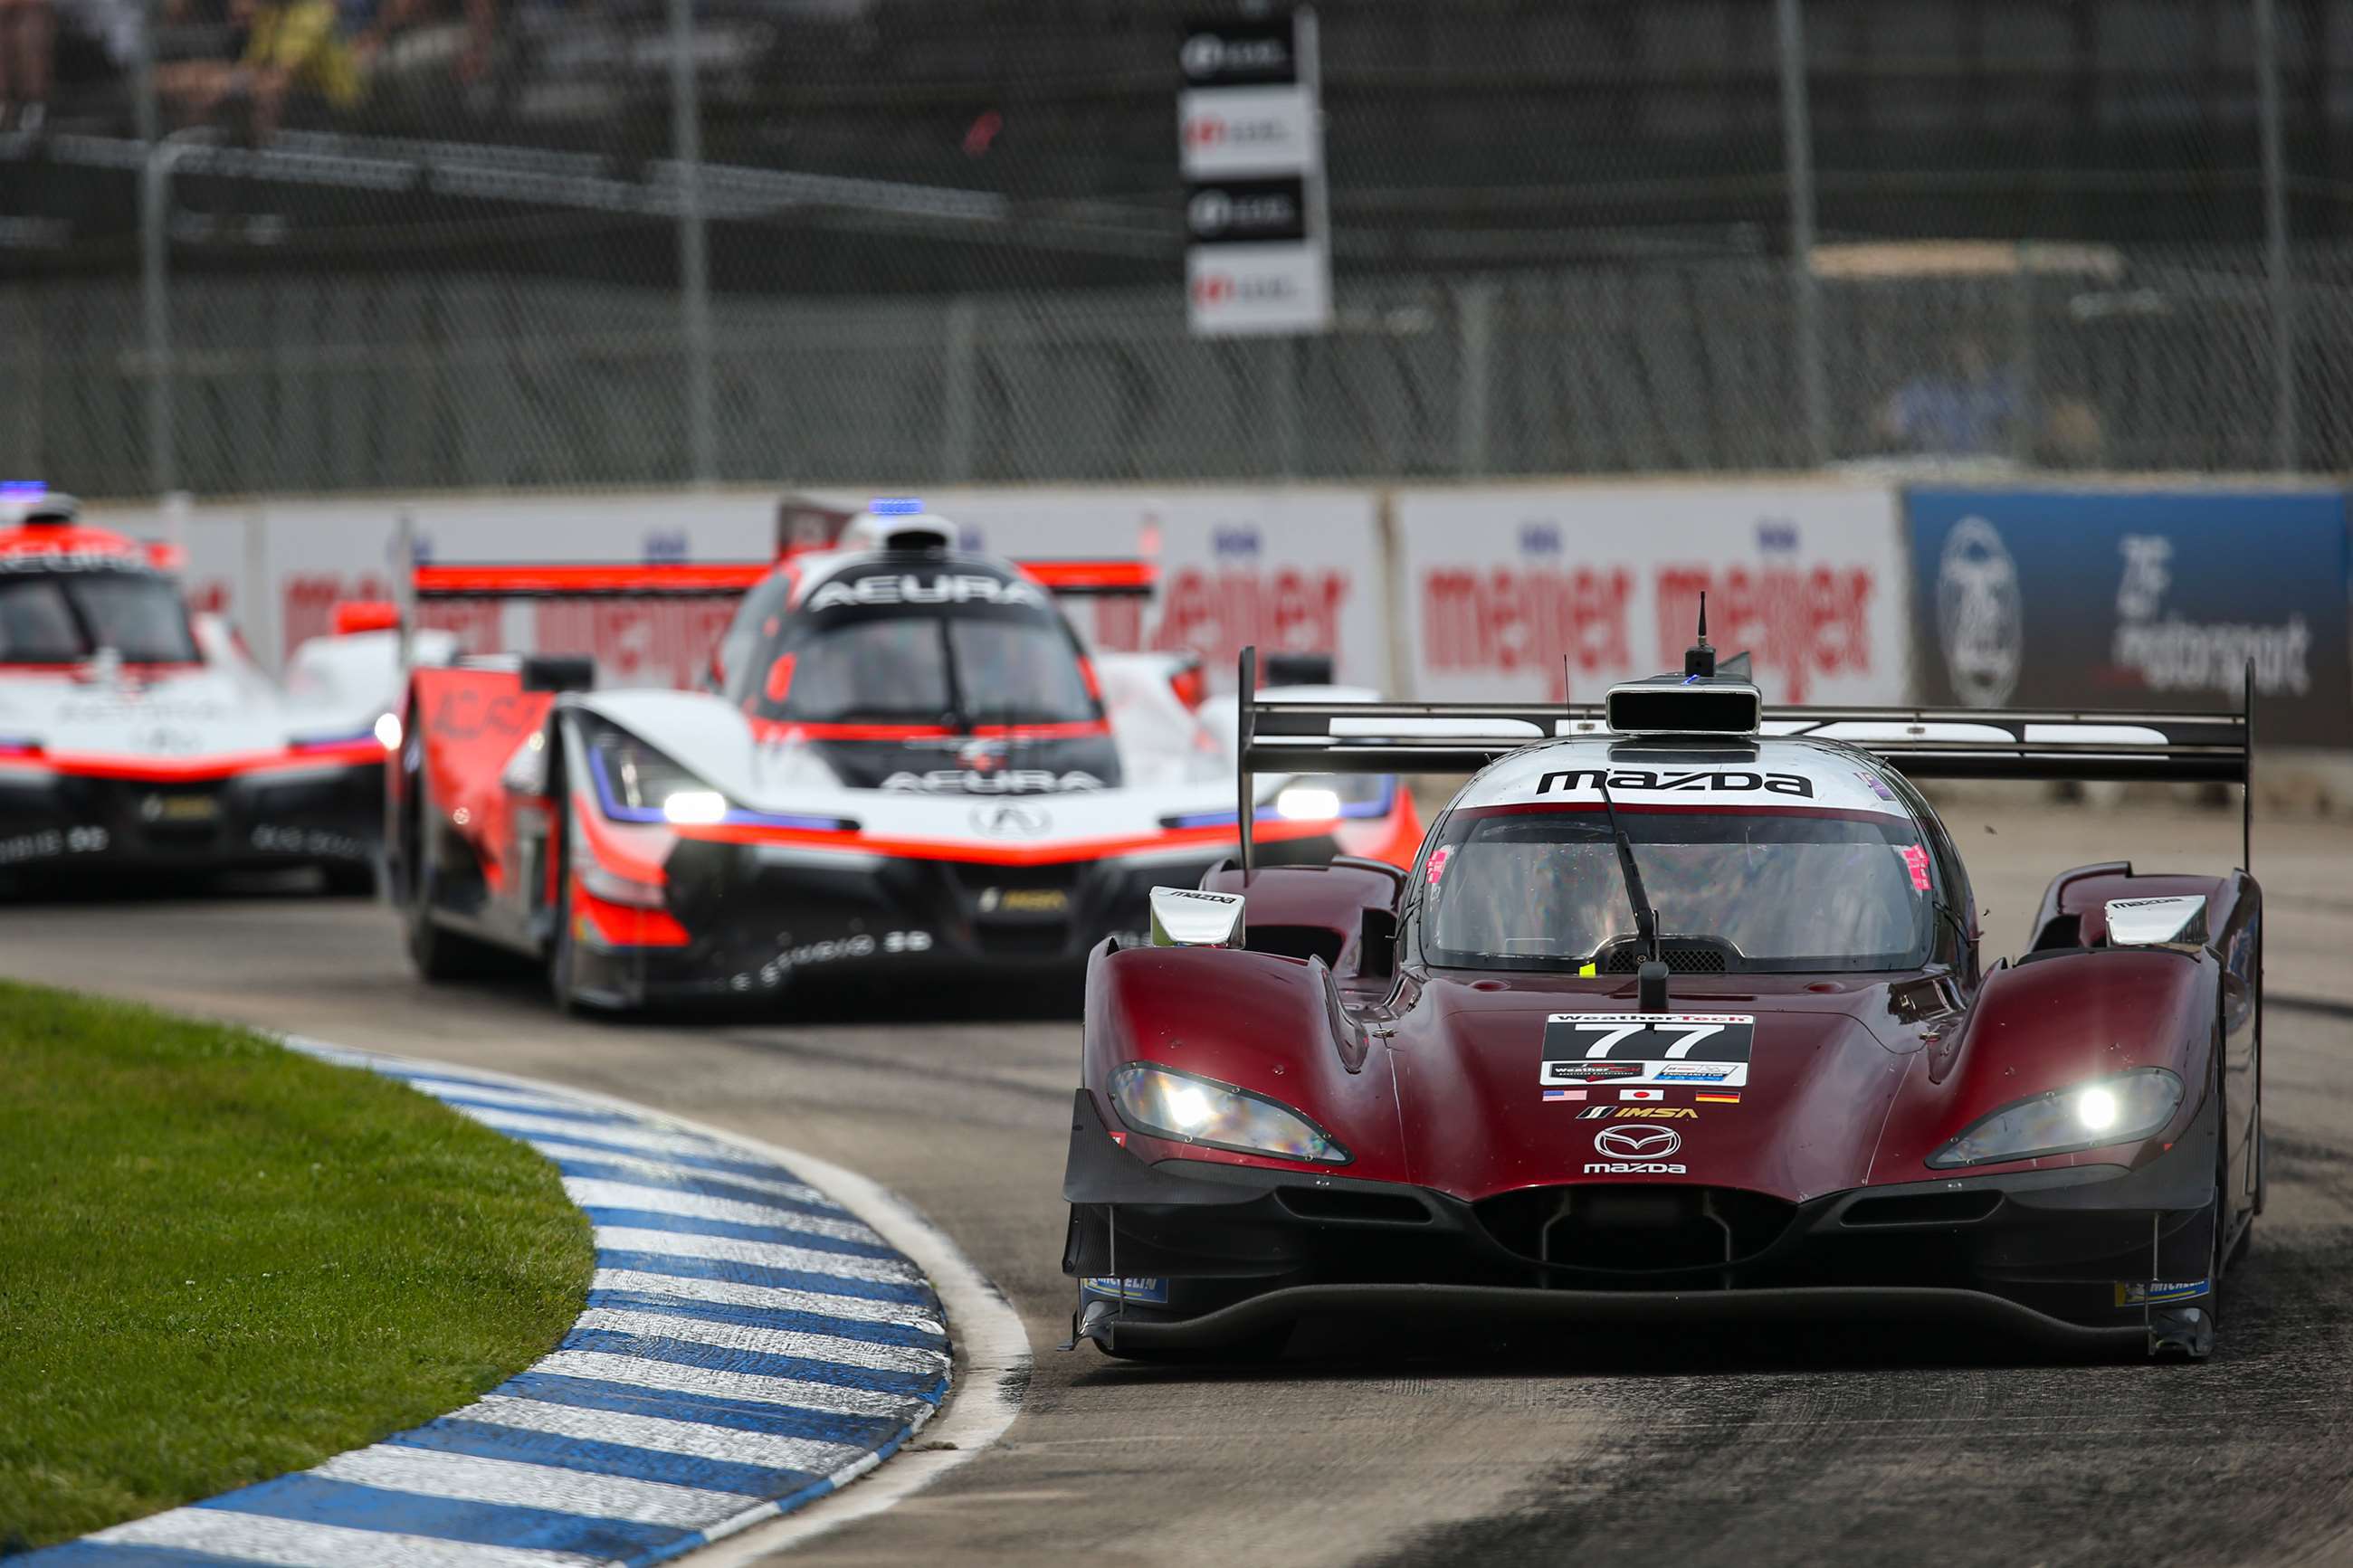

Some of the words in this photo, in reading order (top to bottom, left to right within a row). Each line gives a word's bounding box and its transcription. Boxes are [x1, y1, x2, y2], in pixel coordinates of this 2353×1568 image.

[808, 573, 1047, 612] ACURA
[1424, 566, 1633, 706] meijer
[1653, 565, 1870, 706] meijer
[881, 770, 1104, 794] ACURA
[1536, 769, 1814, 798] mazda
[1170, 891, 1237, 904] mazda
[1557, 1014, 1749, 1022] WeatherTech
[1575, 1022, 1726, 1060] 77
[1614, 1107, 1699, 1119] IMSA
[1584, 1163, 1687, 1174] mazda
